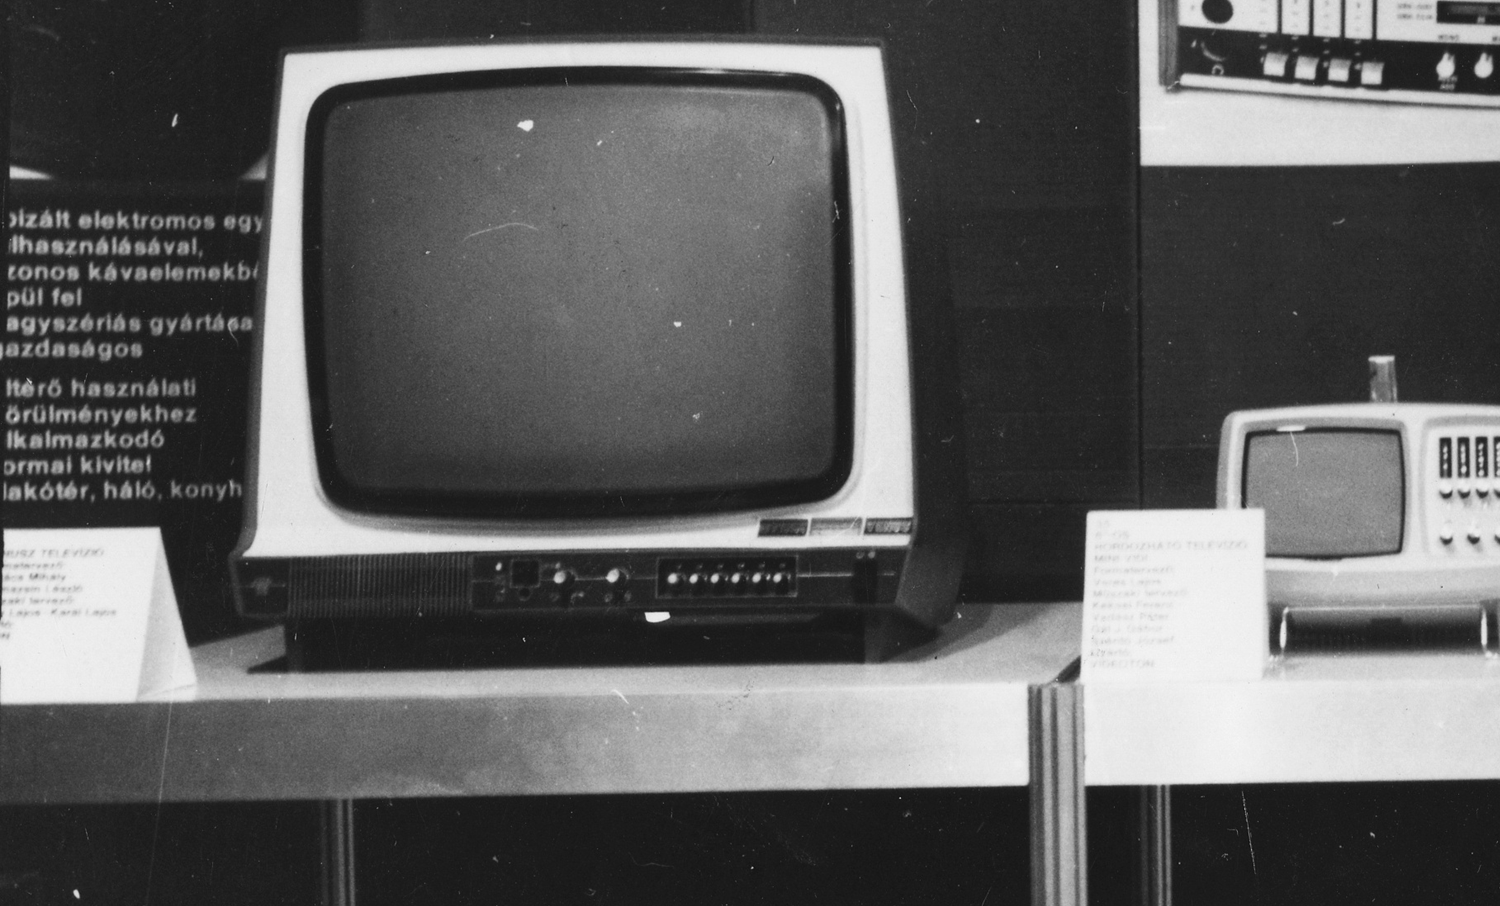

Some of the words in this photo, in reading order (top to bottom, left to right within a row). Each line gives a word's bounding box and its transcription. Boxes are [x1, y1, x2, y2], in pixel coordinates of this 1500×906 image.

[78, 209, 216, 231] elektromos
[223, 214, 263, 234] egy
[51, 287, 82, 307] fel
[6, 312, 142, 336] agyszériás
[71, 377, 197, 399] használati
[5, 404, 197, 427] örülményekhez
[6, 429, 165, 449] lkalmazkodó
[80, 455, 152, 475] kivitel
[103, 480, 163, 502] háló,
